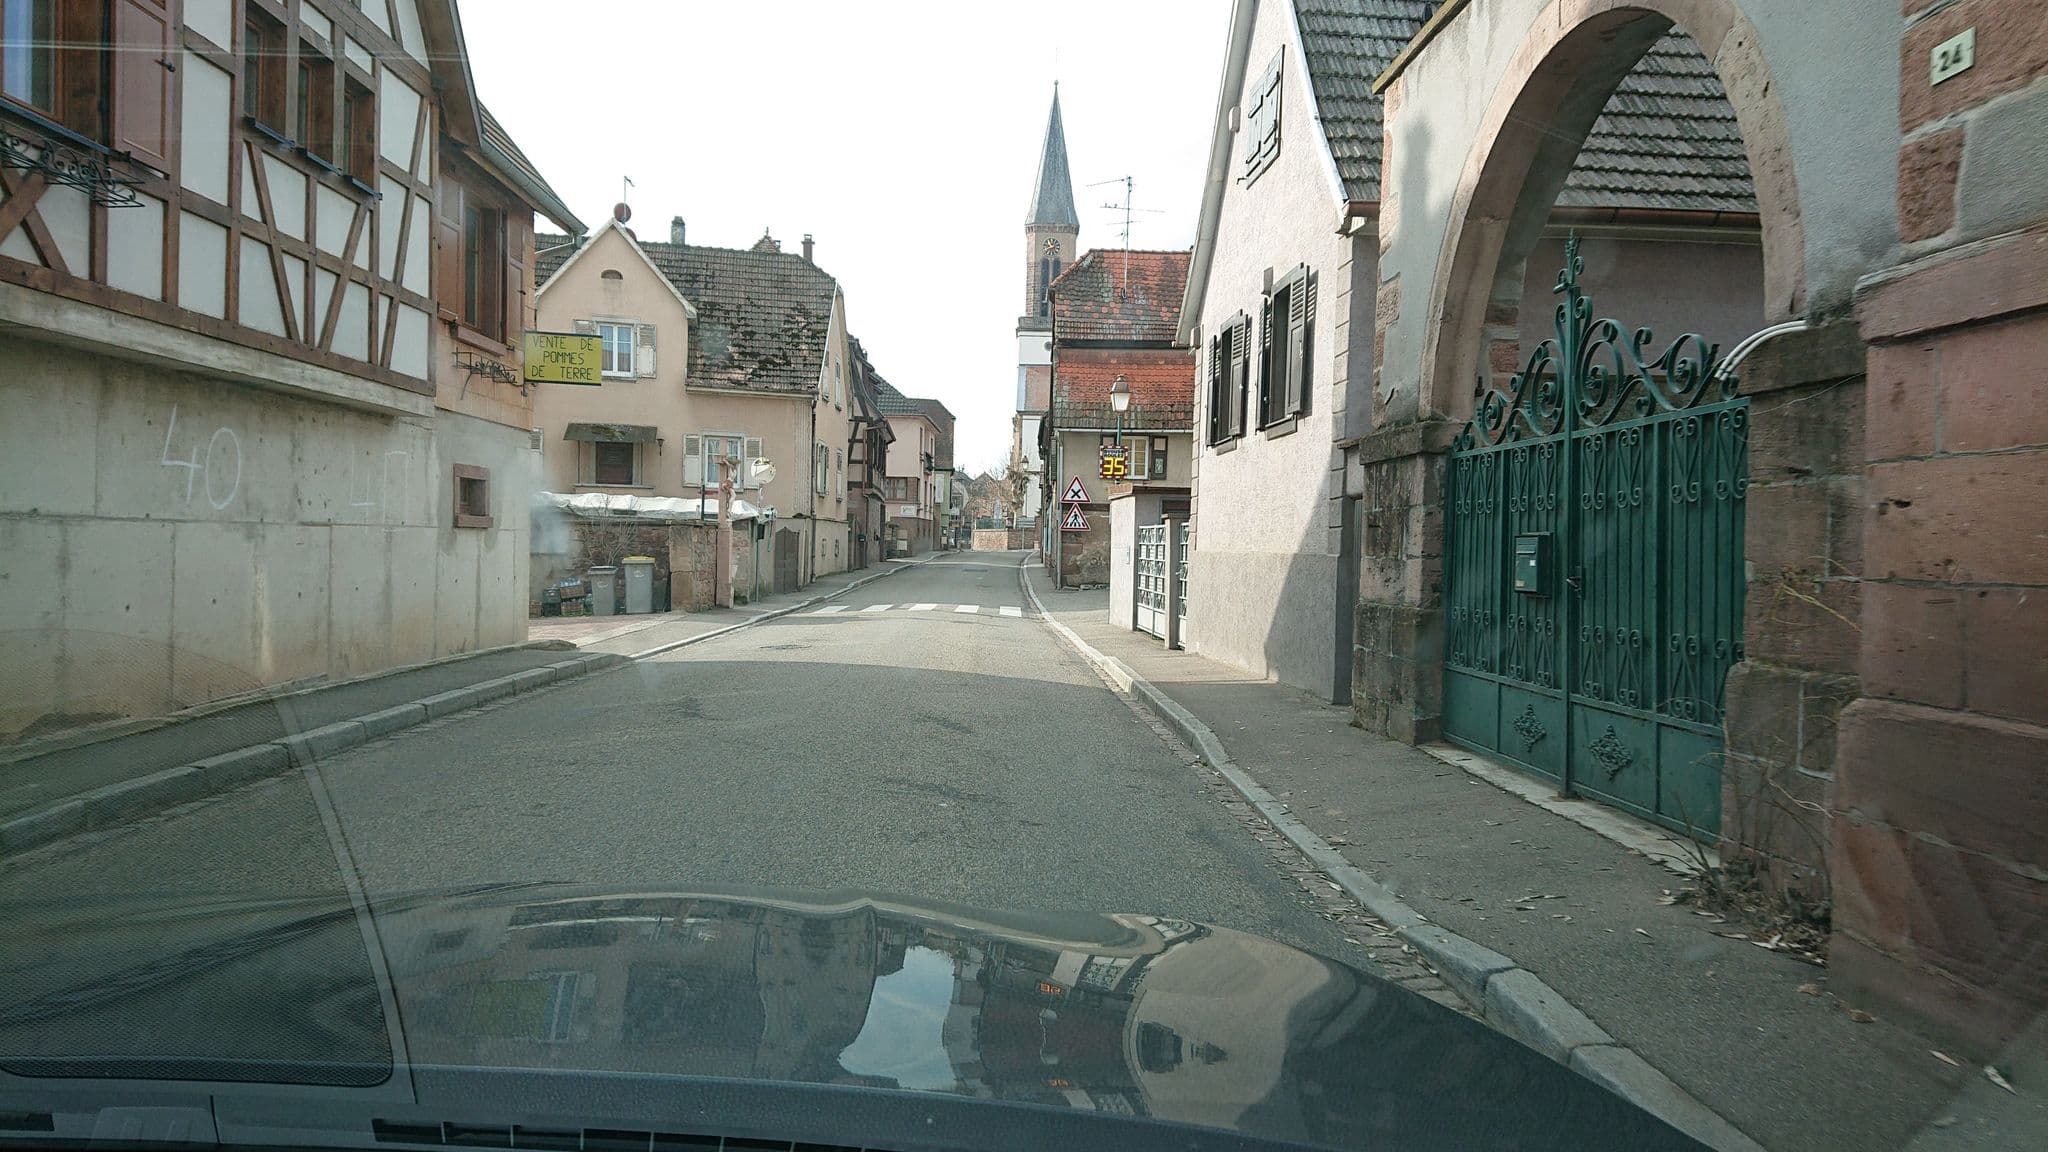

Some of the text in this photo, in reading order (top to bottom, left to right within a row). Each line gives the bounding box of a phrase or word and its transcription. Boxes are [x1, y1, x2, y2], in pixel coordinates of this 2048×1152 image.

[531, 335, 594, 351] VENTE DE
[543, 350, 585, 365] POMMES
[531, 365, 593, 381] DE TERRE
[160, 403, 241, 511] 40
[1103, 457, 1124, 475] 35
